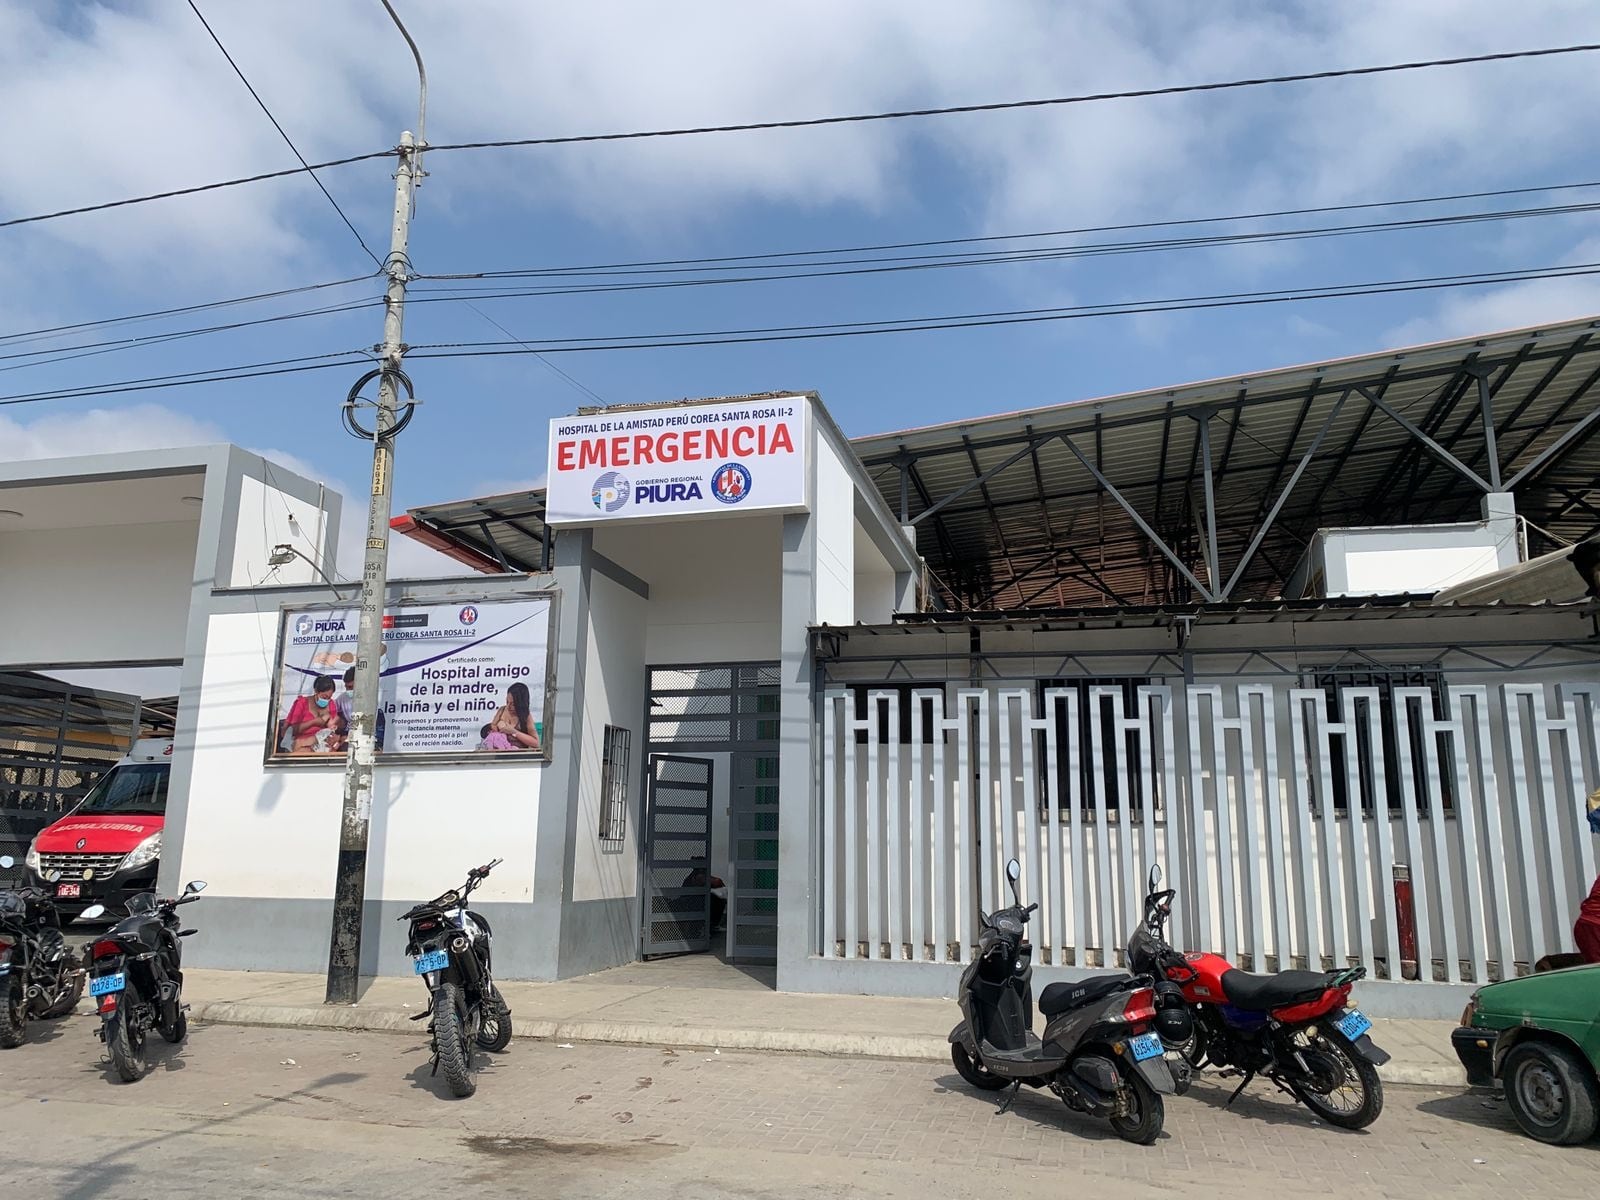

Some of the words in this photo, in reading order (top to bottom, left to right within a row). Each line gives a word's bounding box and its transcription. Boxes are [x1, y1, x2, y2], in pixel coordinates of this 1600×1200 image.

[558, 424, 598, 436] HOSPITAL
[600, 423, 612, 432] DE
[614, 422, 624, 431] LA
[626, 418, 664, 430] AMISTAD
[666, 413, 689, 426] PERÚ
[691, 413, 720, 424] COREA
[722, 411, 750, 421] SANTA
[752, 408, 776, 419] ROSA
[778, 407, 793, 417] II-2
[557, 423, 794, 471] EMERGENCIA
[635, 477, 669, 486] GOBIERNO
[670, 475, 703, 483] REGIONAL
[635, 482, 703, 504] PIURA
[315, 621, 346, 632] PIURA
[293, 635, 323, 644] HOSPITAL
[381, 630, 394, 639] ERÚ
[395, 631, 419, 639] COREA
[444, 629, 462, 637] ROSA
[421, 665, 480, 681] Hospital
[485, 664, 530, 678] amigo
[410, 683, 427, 696] de
[432, 682, 444, 695] la
[449, 681, 499, 695] madre,
[384, 701, 396, 714] la
[401, 699, 430, 713] niña
[434, 702, 442, 714] y
[447, 698, 459, 711] el
[465, 698, 499, 711] niño.
[391, 717, 427, 725] Protegemos
[456, 731, 468, 739] piel
